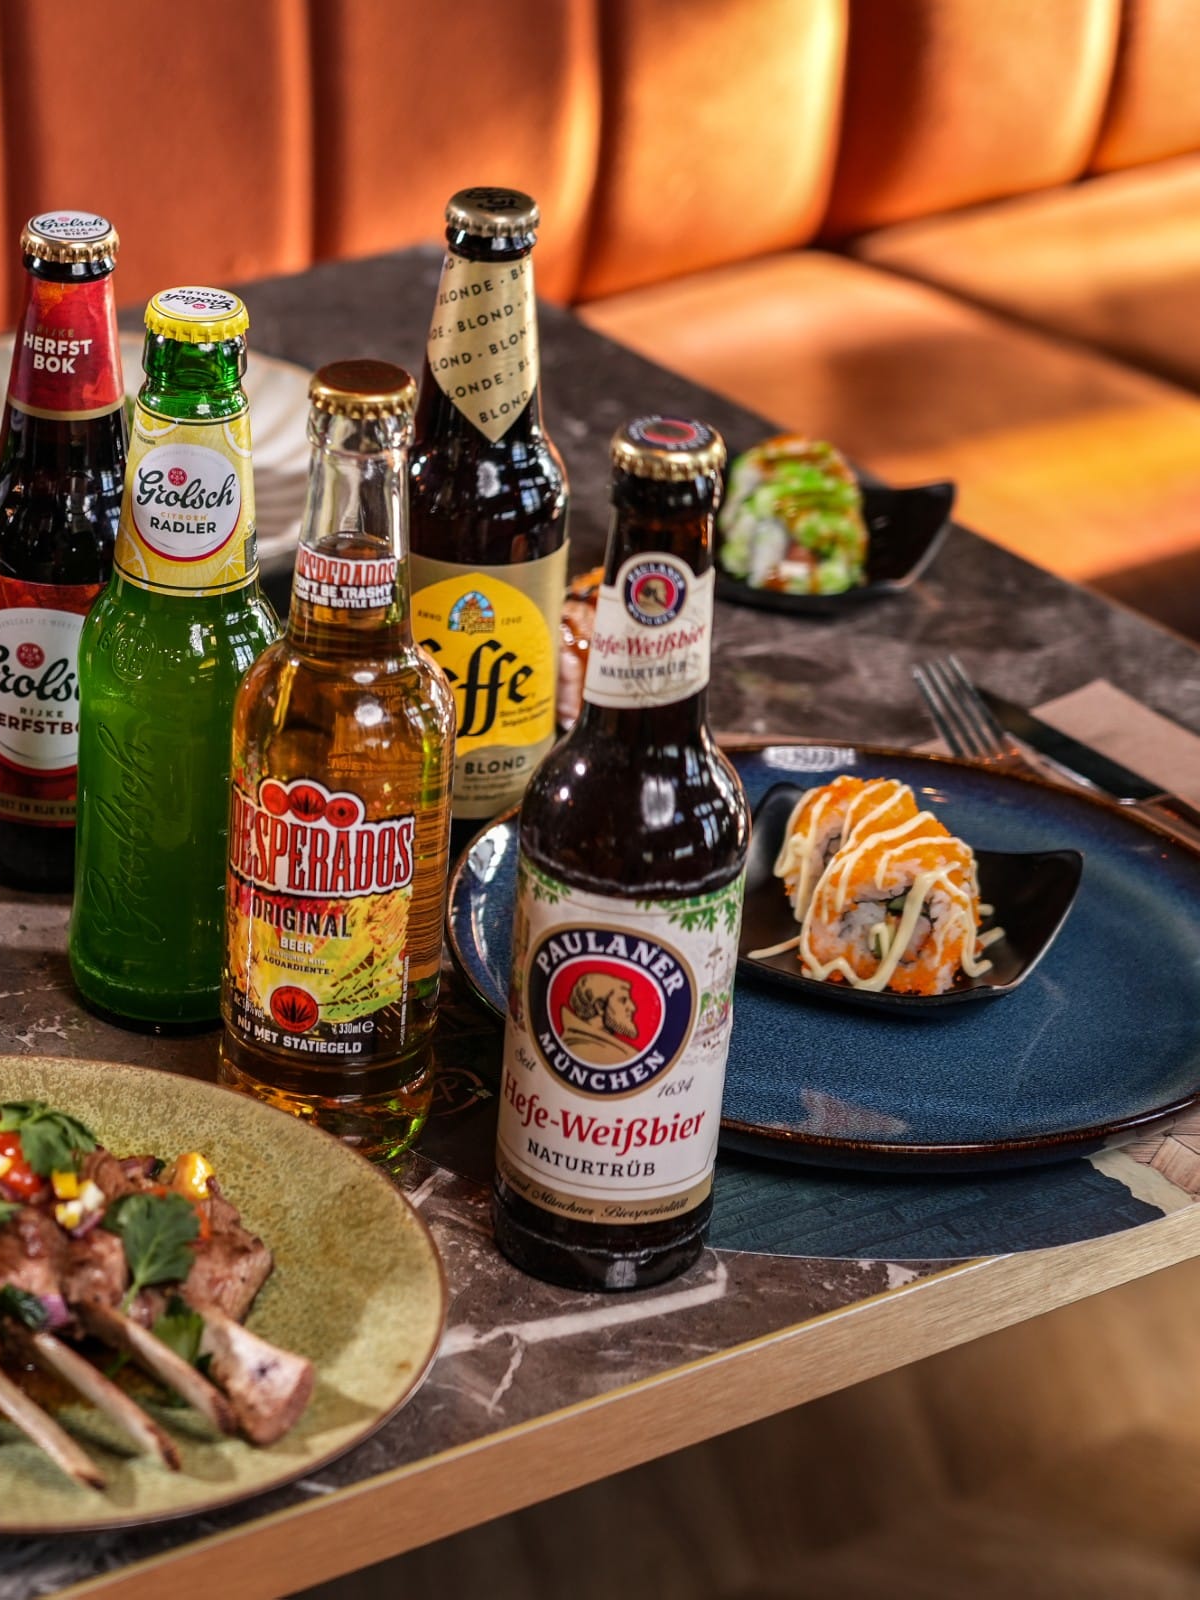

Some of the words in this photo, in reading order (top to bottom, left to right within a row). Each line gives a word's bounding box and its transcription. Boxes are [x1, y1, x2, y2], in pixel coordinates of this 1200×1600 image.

[36, 218, 103, 230] Grolsch
[160, 293, 235, 311] Grolsch
[179, 289, 227, 299] RADLER
[456, 303, 515, 333] BLOND
[23, 331, 93, 356] HERFST
[33, 353, 76, 374] BOK
[446, 373, 504, 401] LONDE
[478, 389, 530, 425] BLOND
[136, 467, 236, 509] Grolsch
[150, 516, 217, 534] RADLER
[321, 584, 338, 598] BE
[341, 583, 393, 599] TRASHY
[330, 599, 367, 609] BOTTLE
[419, 639, 533, 738] ffe
[19, 706, 65, 719] RIJKE
[464, 755, 526, 775] BLOND
[231, 788, 412, 893] DESPERADOS
[252, 895, 353, 939] ORIGINAL
[280, 937, 314, 955] BEER
[536, 931, 685, 998] PAULANER
[237, 1015, 252, 1032] NU
[254, 1024, 279, 1044] MET
[283, 1036, 362, 1054] STATIEGELD
[339, 1022, 361, 1034] 330ml
[514, 1047, 537, 1073] Seit
[539, 1031, 666, 1091] MÜNCHEN
[657, 1076, 695, 1099] 1634
[503, 1070, 707, 1157] Hefe-Weißbier
[527, 1137, 657, 1178] NATURTRÜB
